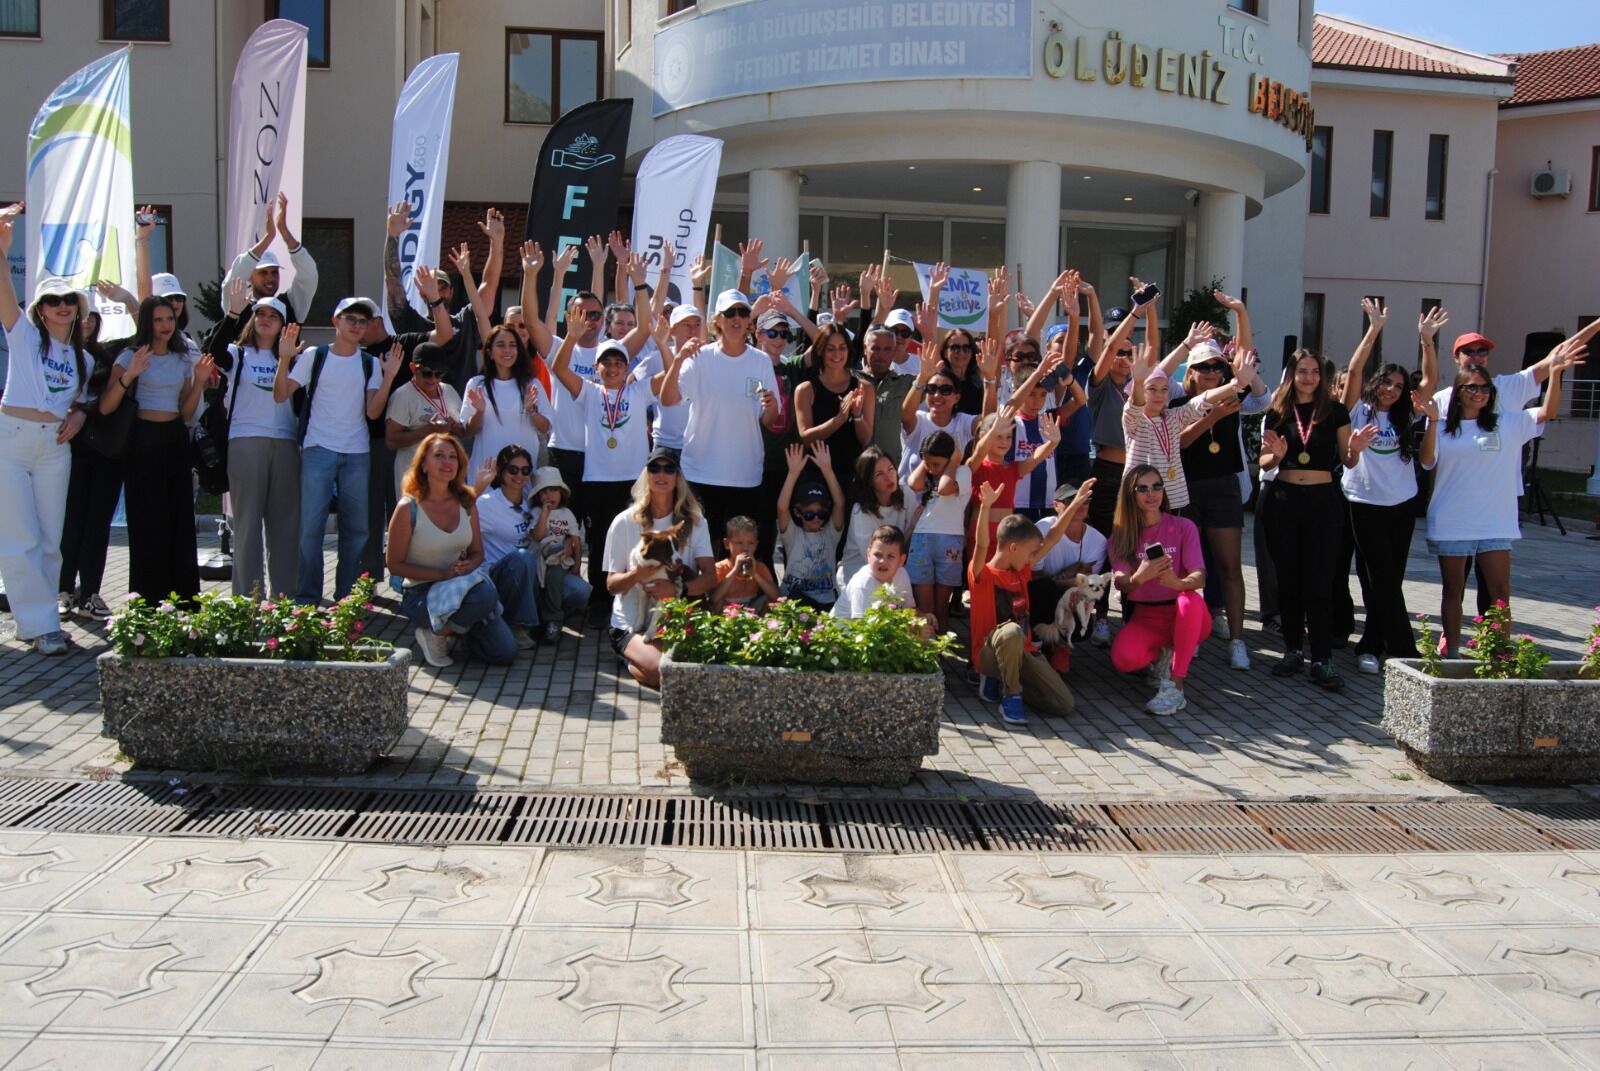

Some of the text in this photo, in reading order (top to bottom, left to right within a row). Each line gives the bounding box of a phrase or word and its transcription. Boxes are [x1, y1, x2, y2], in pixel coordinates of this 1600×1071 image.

[704, 0, 1016, 56] MUĞLA BÜYÜKŞEHİR BELEDİYESİ
[735, 36, 966, 83] FETHİYE HİZMET BİNASI
[1044, 19, 1231, 105] ÖLÜDENİZ
